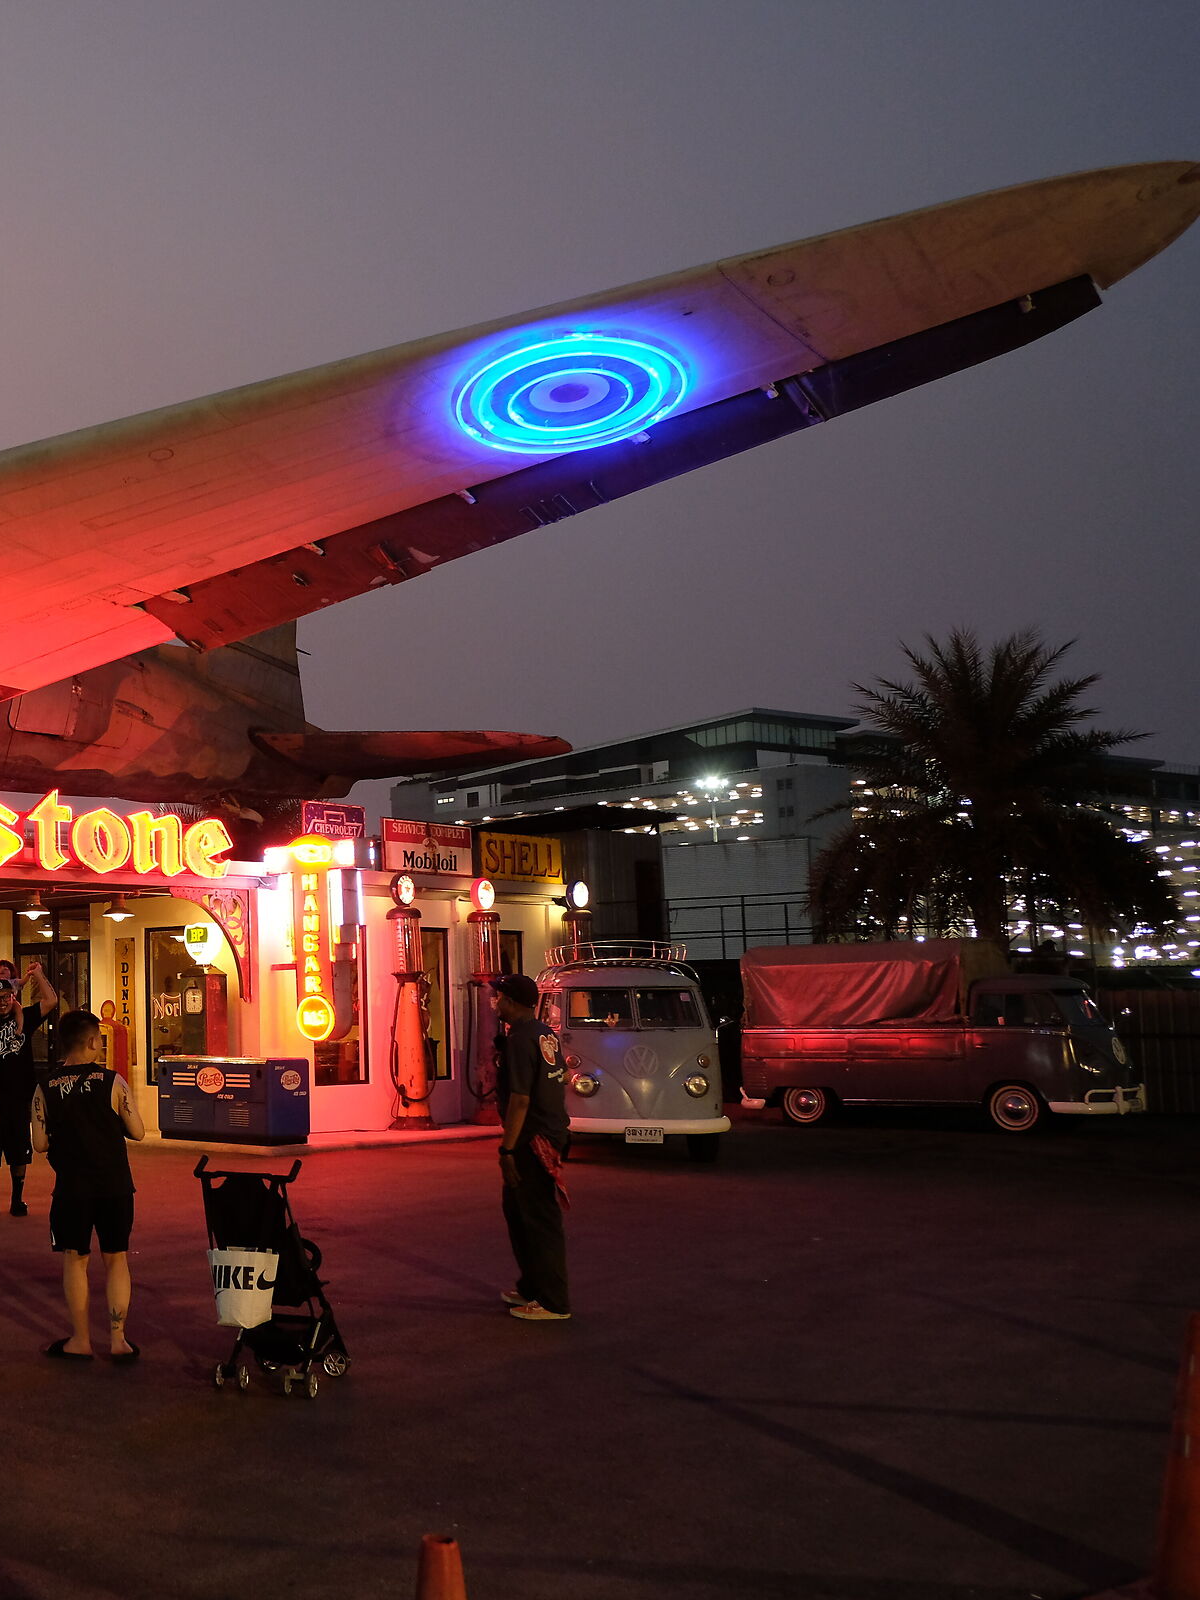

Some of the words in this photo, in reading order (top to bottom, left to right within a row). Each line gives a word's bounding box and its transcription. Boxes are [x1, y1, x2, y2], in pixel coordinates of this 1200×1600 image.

[315, 823, 359, 837] CHEVROLET
[392, 822, 427, 837] SERVICE
[431, 827, 466, 840] COMPLET
[403, 850, 458, 872] Mobiloil
[485, 838, 562, 878] SHELL
[190, 928, 204, 943] BP
[301, 873, 322, 993] HANGAR
[121, 962, 131, 1026] DUNLO
[644, 1129, 662, 1137] 7471
